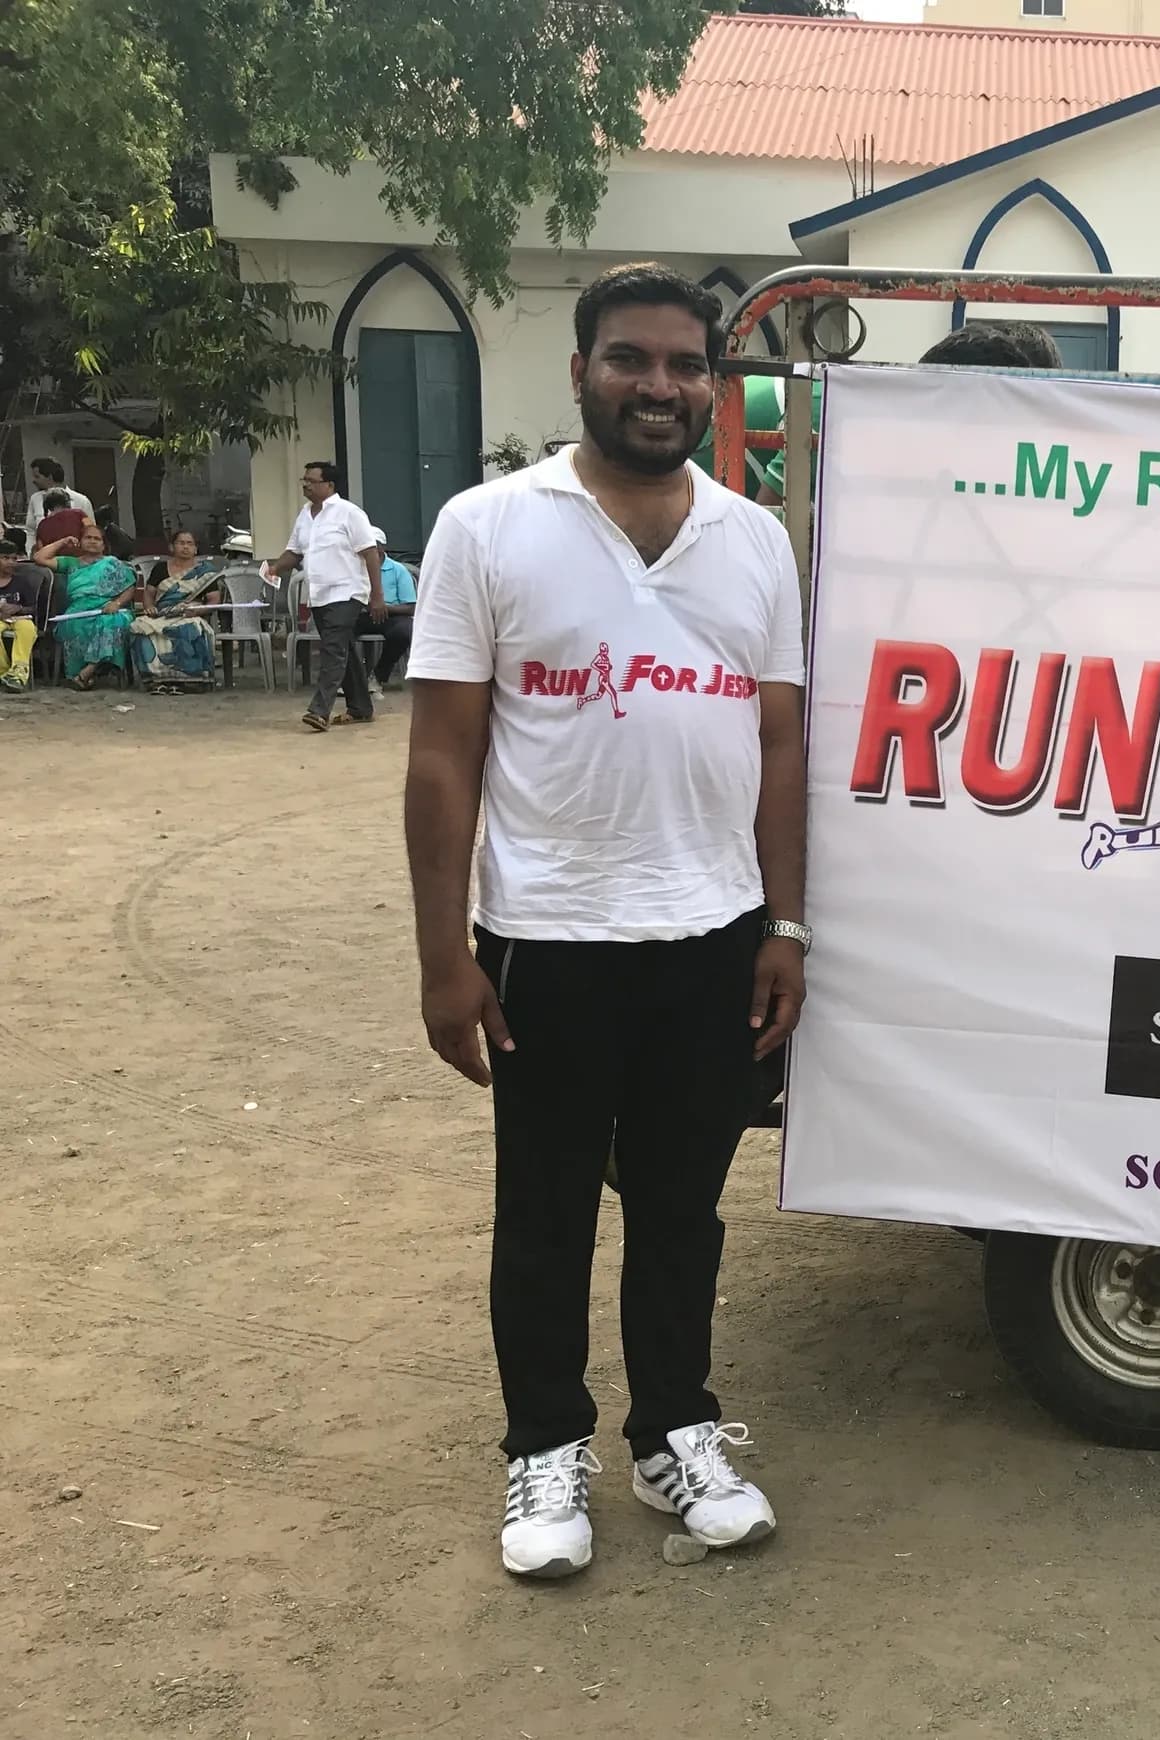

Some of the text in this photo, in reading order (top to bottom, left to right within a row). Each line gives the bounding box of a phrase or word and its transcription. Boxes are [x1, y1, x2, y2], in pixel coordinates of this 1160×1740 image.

[954, 442, 1112, 517] ...My
[519, 660, 592, 697] RUN
[618, 655, 698, 693] FOR
